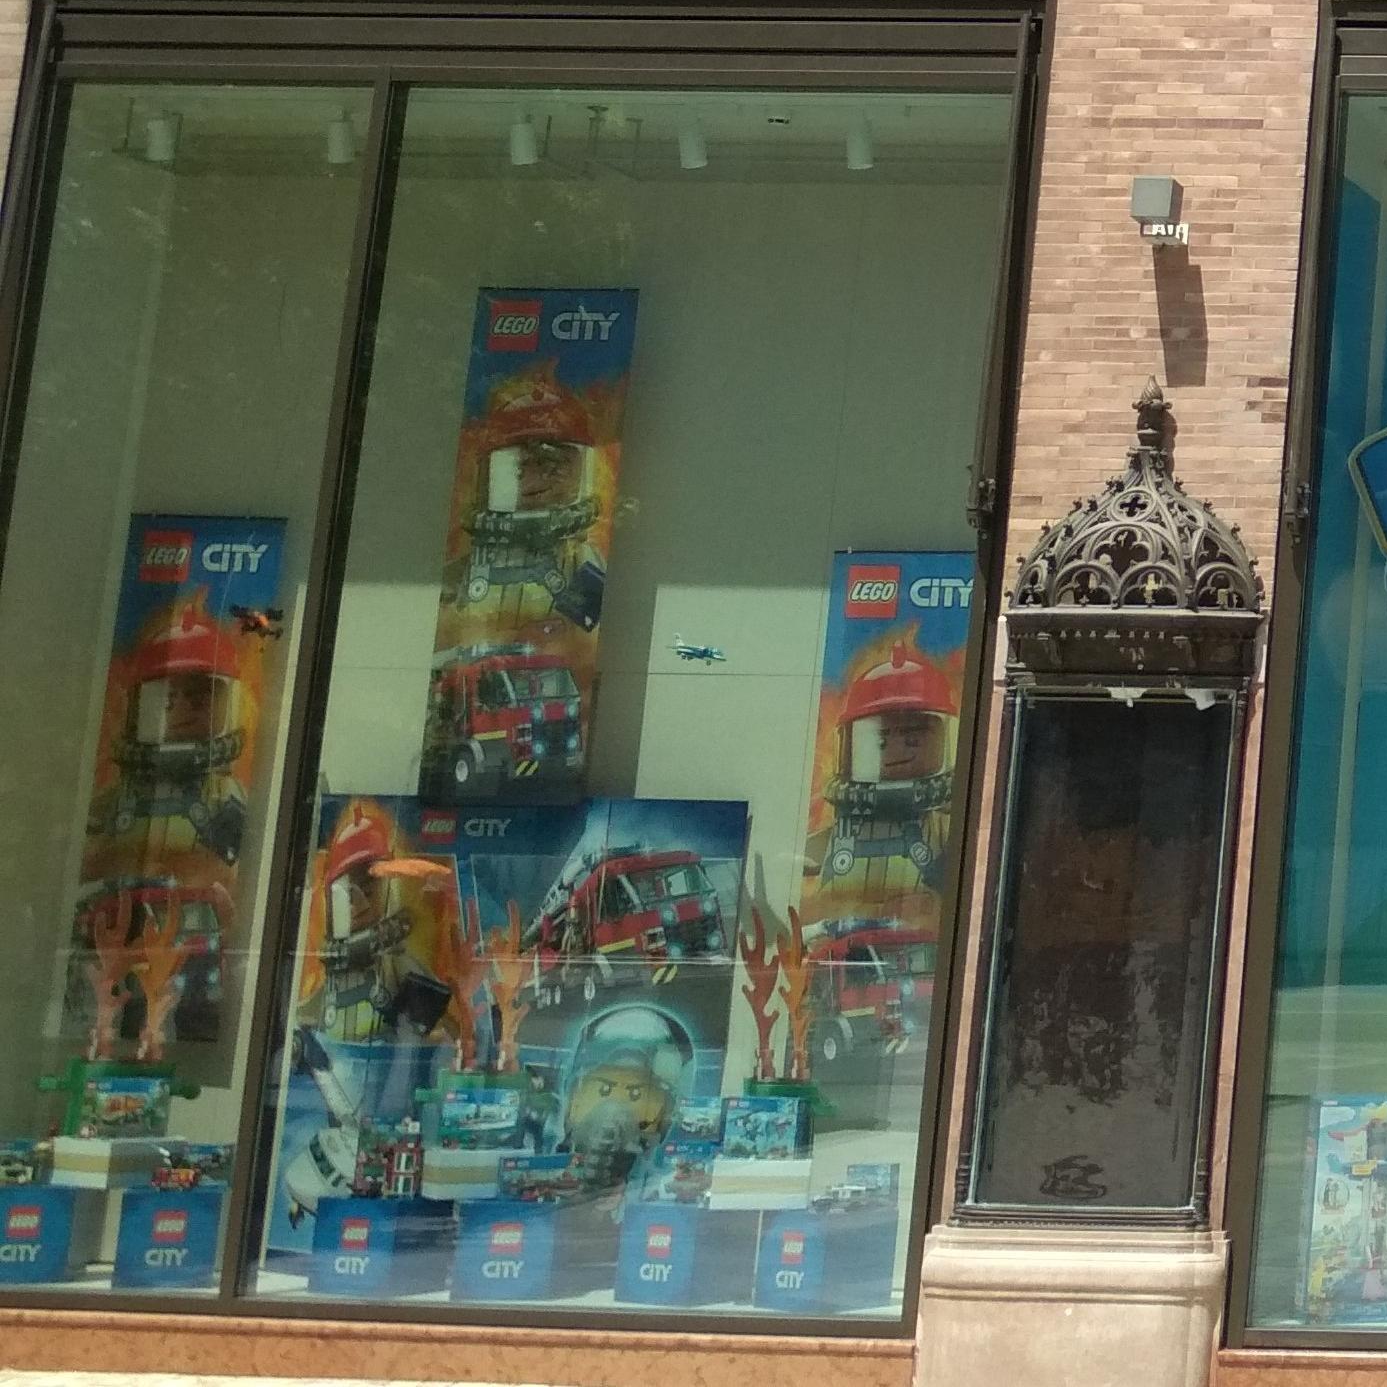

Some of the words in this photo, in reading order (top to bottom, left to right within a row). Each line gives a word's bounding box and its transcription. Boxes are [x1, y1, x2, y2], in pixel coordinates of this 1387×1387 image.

[492, 315, 538, 335] LEGO
[551, 311, 620, 340] CITY
[202, 543, 268, 573] CITY
[850, 581, 896, 602] LEGO
[910, 578, 974, 608] CITY
